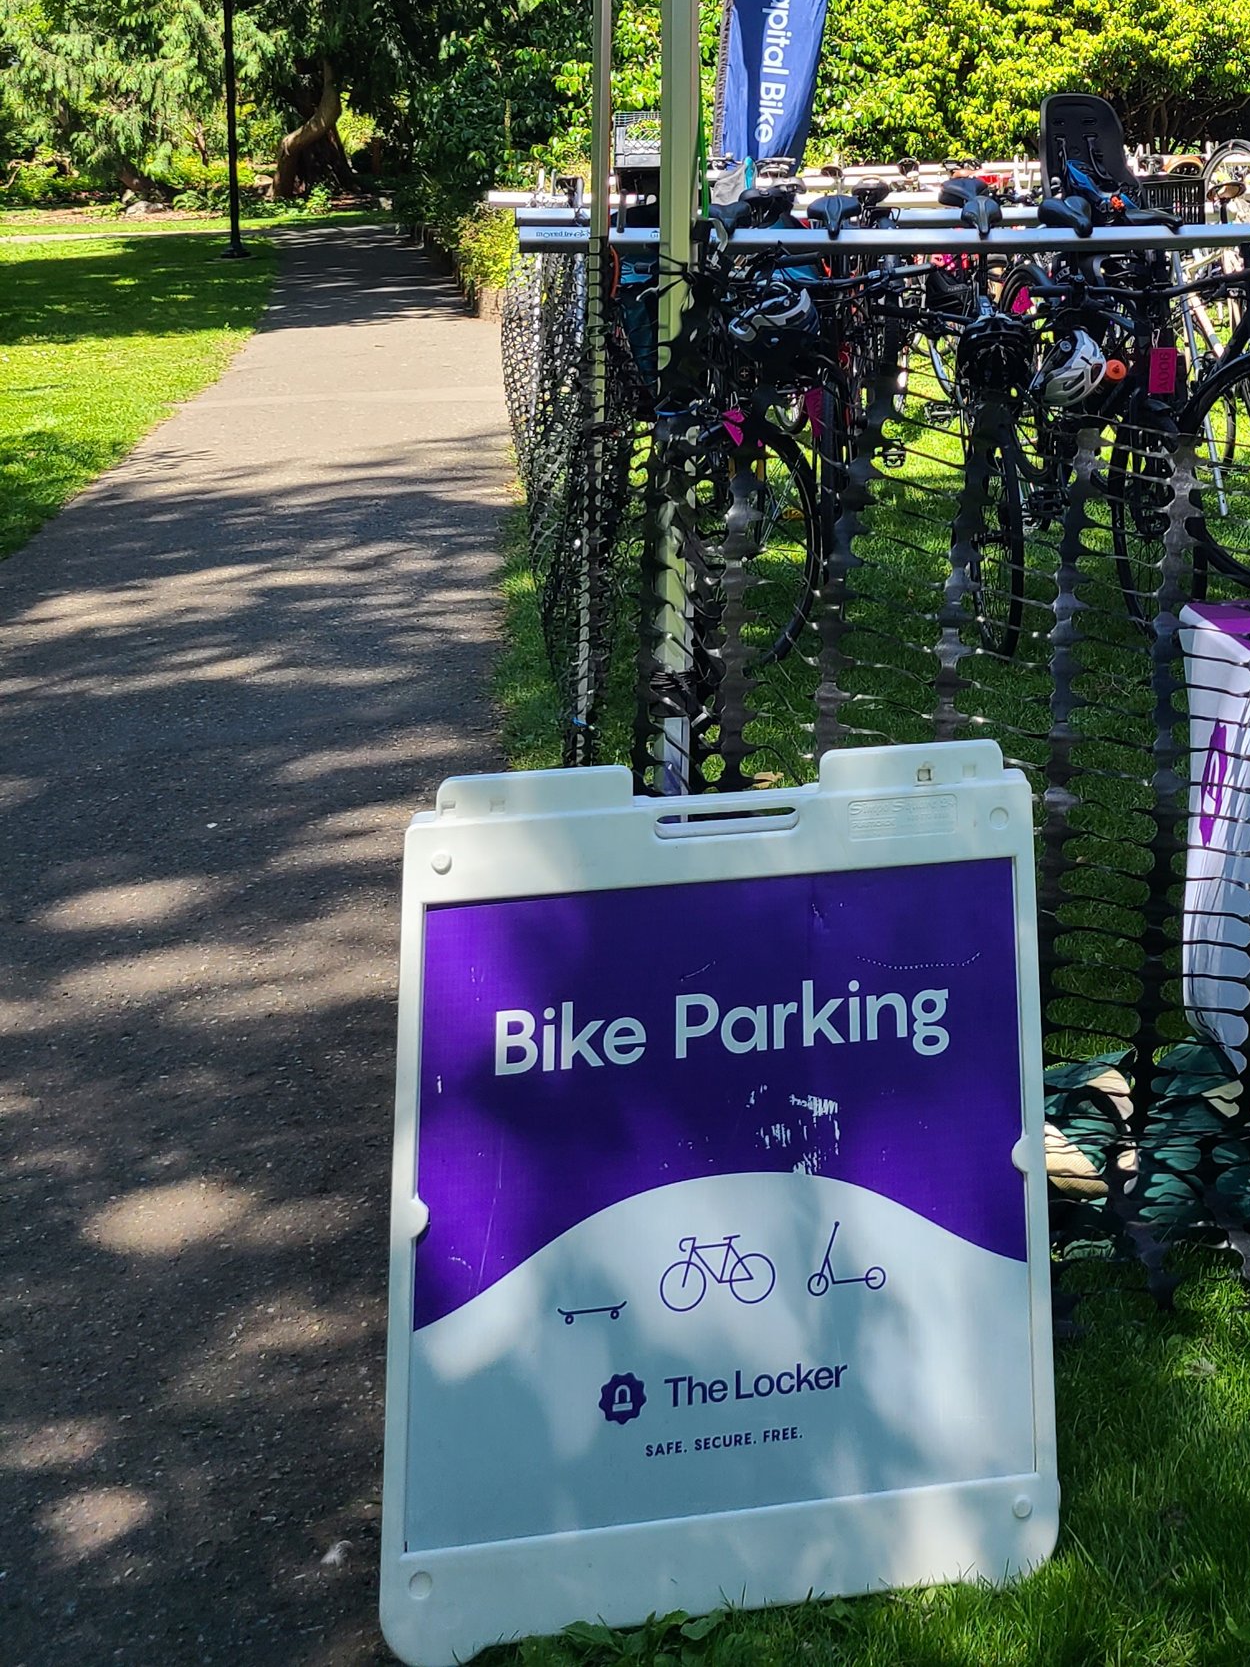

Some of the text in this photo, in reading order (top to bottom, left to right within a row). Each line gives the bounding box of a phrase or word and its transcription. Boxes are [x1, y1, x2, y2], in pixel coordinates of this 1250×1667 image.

[754, 80, 787, 144] Bike
[494, 979, 951, 1076] Bike Parking
[664, 1363, 849, 1408] The Locker
[645, 1425, 803, 1458] SAFE. SECURE. FREE.
